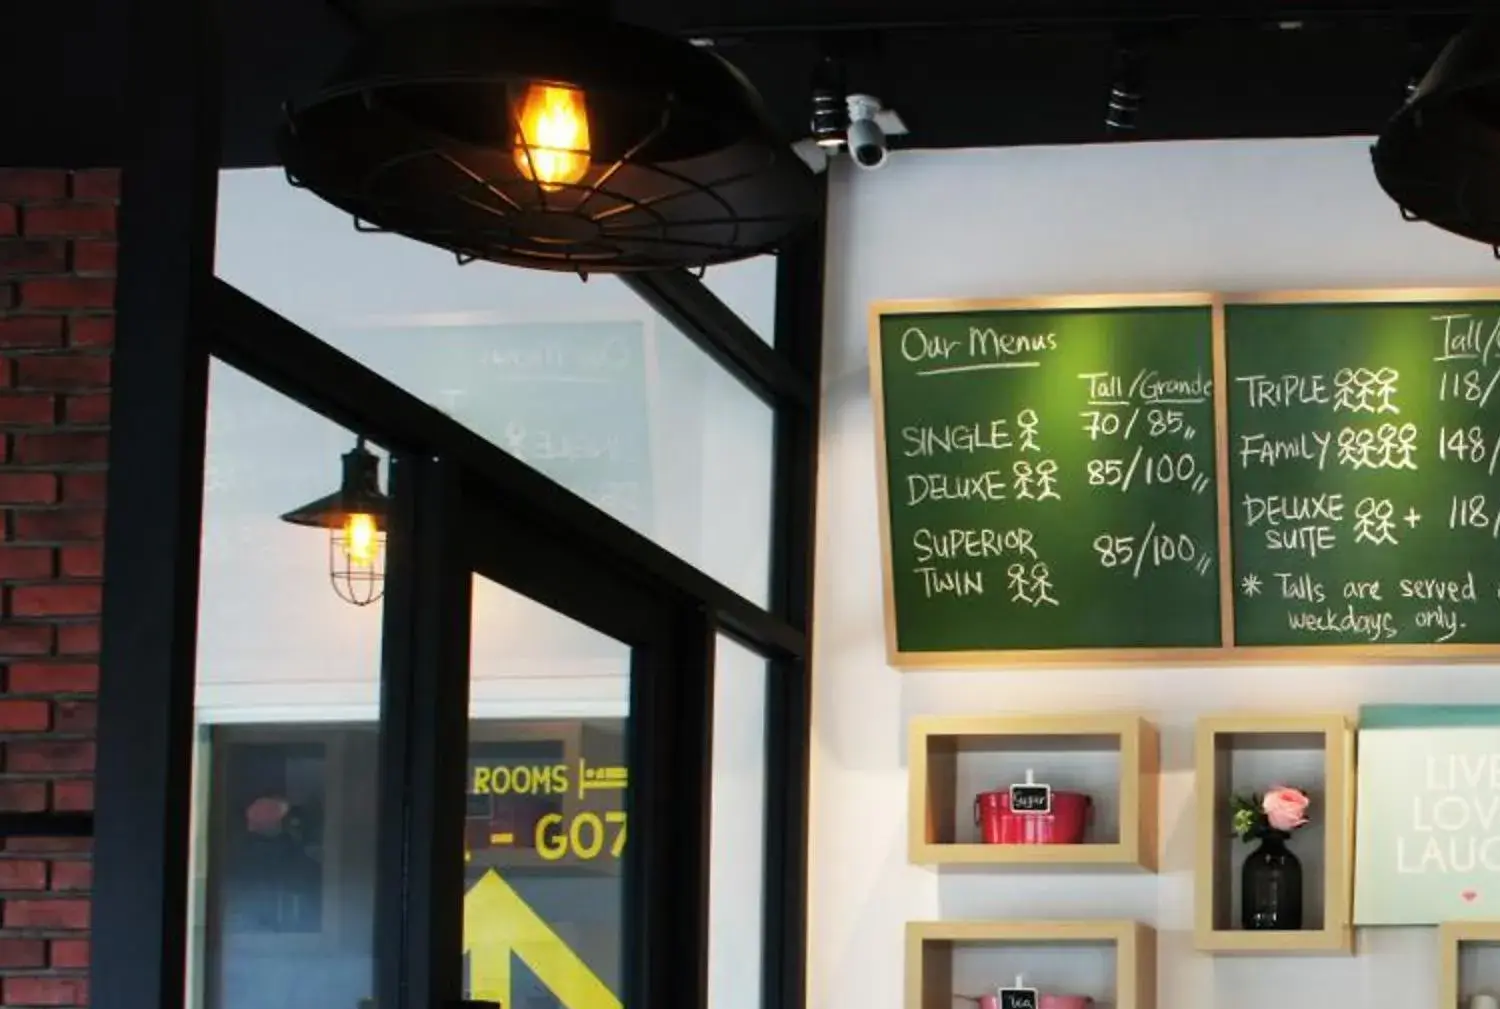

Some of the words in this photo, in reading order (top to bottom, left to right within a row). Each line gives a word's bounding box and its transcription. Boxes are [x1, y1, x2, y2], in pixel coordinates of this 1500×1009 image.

[901, 327, 961, 362] Our
[968, 327, 1057, 357] Menus
[1236, 375, 1330, 409] TRIPLE
[901, 419, 1013, 456] SINGLE
[907, 471, 1006, 506] DELUXE
[1244, 493, 1345, 527] DELUXE
[914, 528, 1037, 562] SUPERIOR
[1265, 526, 1336, 558] SUITE
[913, 567, 984, 597] TWIN
[1273, 572, 1327, 602] Talls
[1344, 580, 1382, 601] are
[1400, 571, 1477, 603] served
[1289, 606, 1398, 641] weekdays
[473, 765, 569, 795] ROOMS
